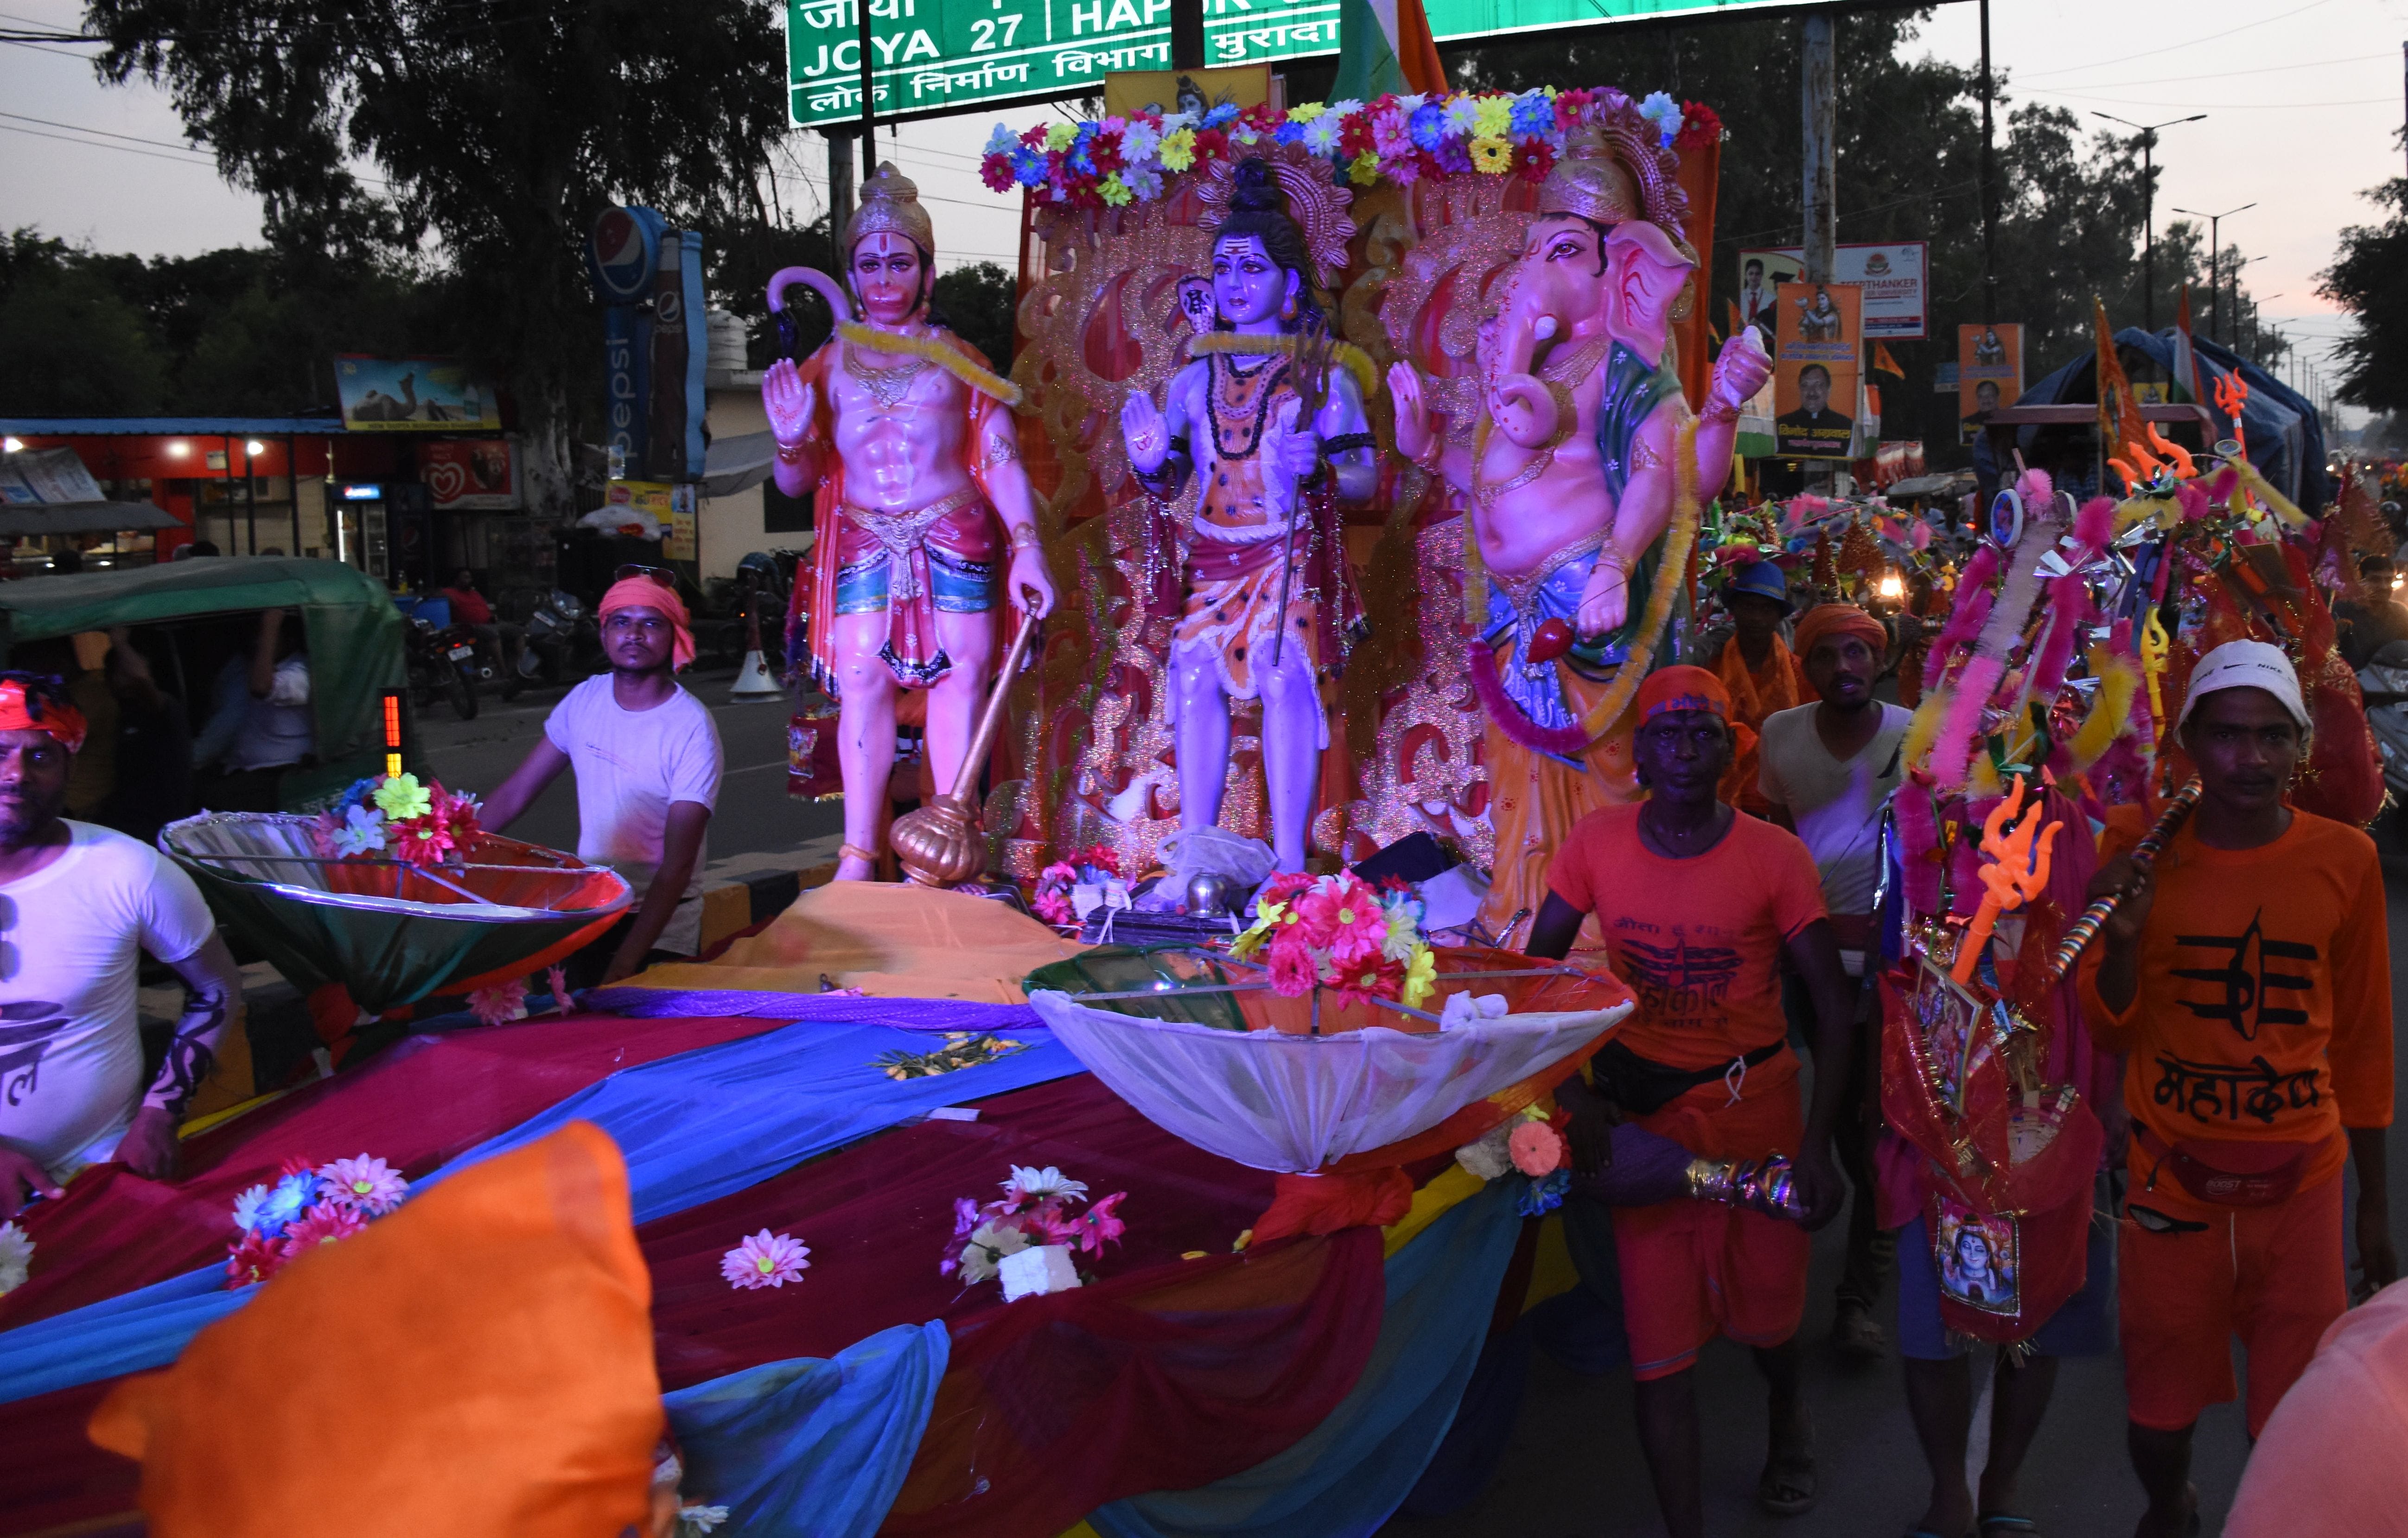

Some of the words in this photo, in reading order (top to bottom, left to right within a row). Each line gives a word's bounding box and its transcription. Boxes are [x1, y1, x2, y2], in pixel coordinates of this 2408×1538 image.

[803, 29, 940, 76] JOYA
[970, 14, 1023, 52] 27
[807, 85, 889, 112] लोक
[910, 62, 1030, 98] निर्माण
[1051, 41, 1171, 77] विभाग
[1210, 19, 1341, 59] मुरादा
[606, 338, 637, 458] pepsi
[2257, 663, 2282, 673] NIKE
[2205, 1180, 2242, 1189] BOOST
